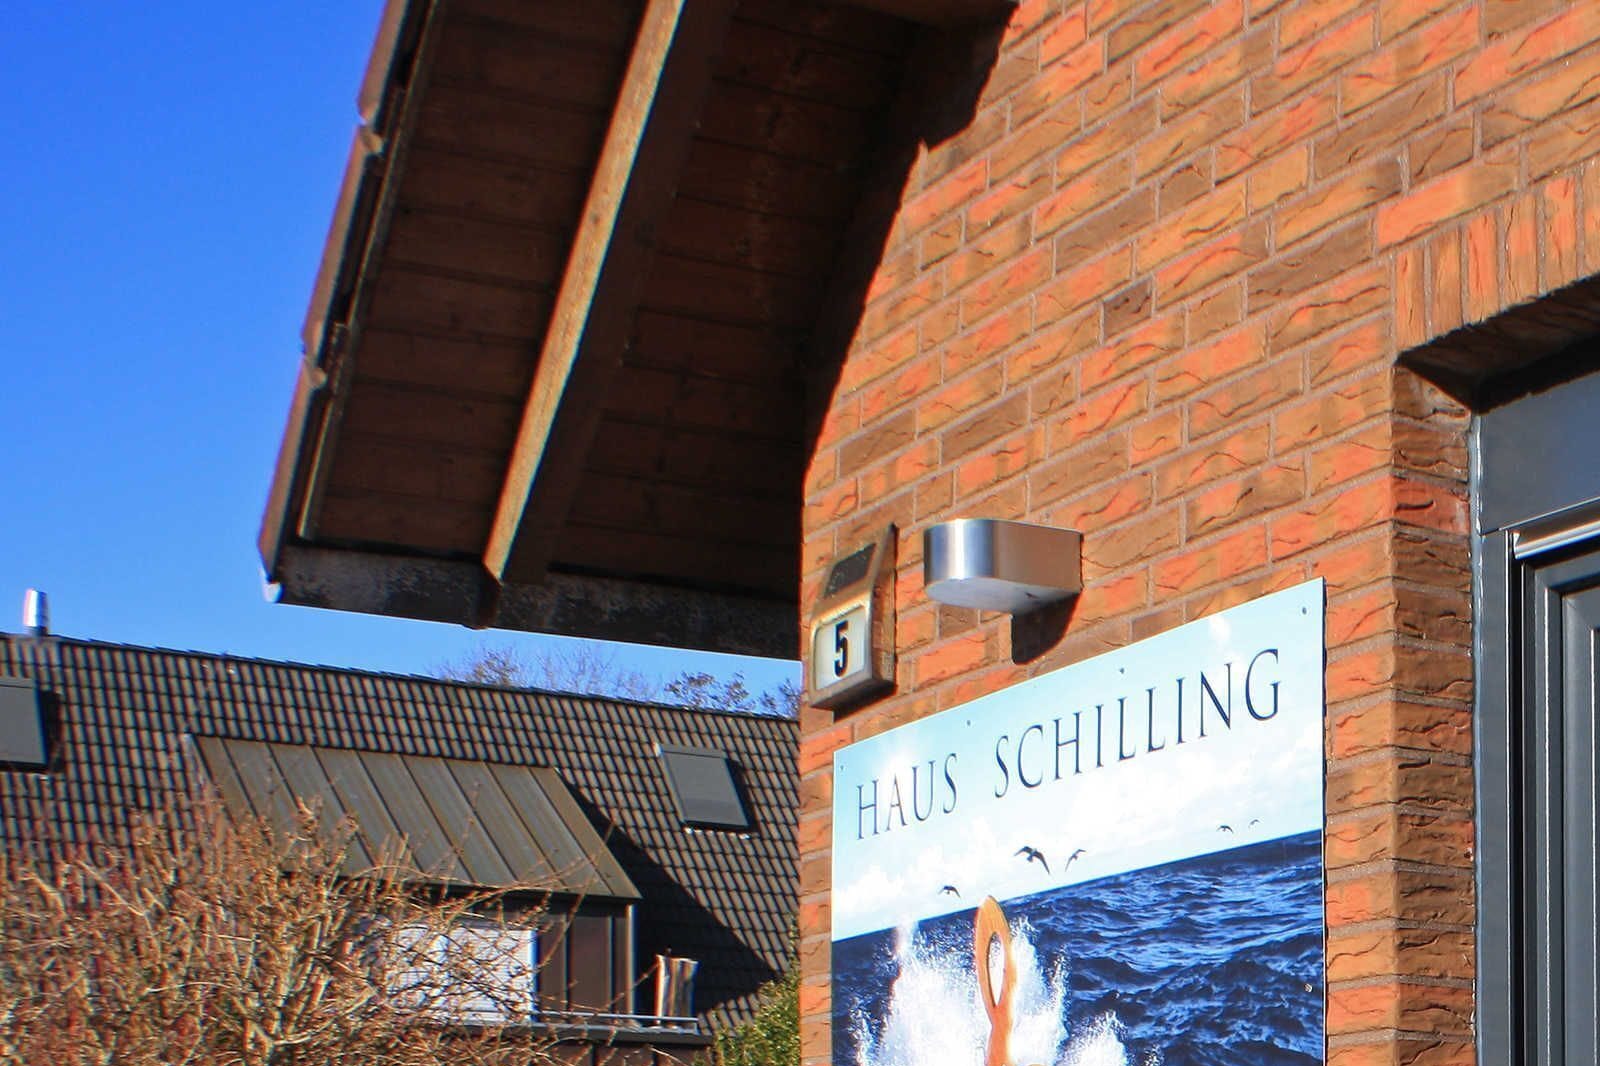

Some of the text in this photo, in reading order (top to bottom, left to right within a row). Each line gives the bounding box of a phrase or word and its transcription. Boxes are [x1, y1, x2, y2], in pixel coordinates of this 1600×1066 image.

[834, 619, 849, 677] 5
[855, 648, 1281, 840] HAUS SCHILLING
